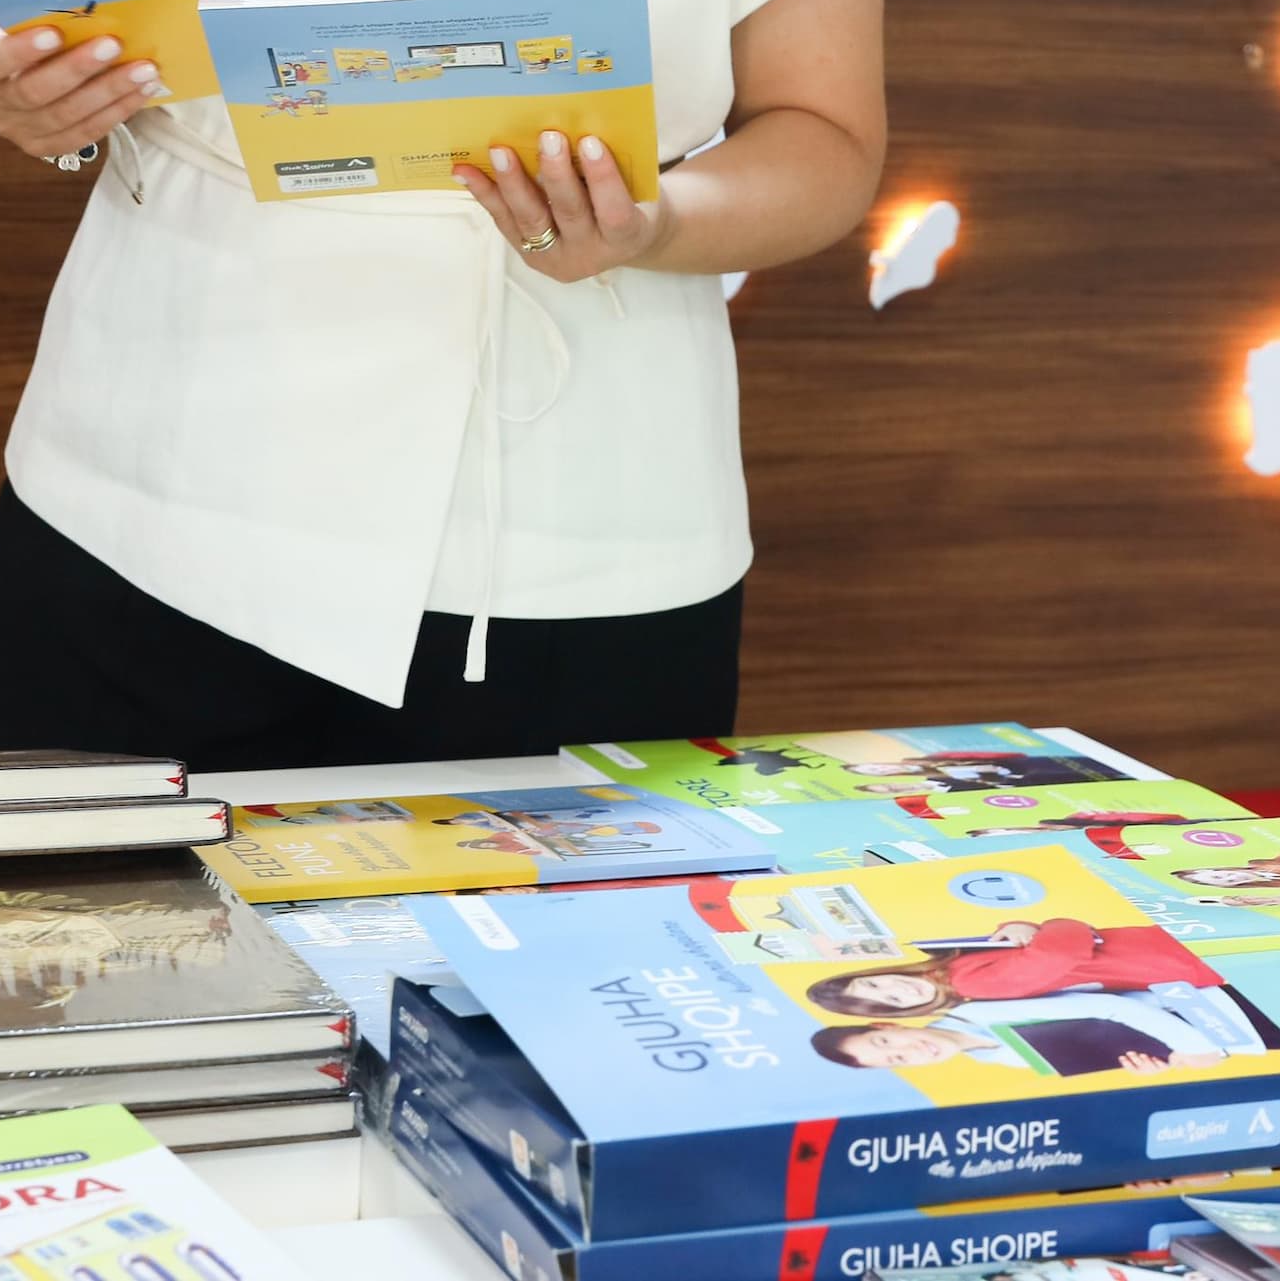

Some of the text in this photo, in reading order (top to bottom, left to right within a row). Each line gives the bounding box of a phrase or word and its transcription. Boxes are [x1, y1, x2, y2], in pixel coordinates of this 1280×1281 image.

[676, 778, 749, 807] TORE
[276, 842, 344, 877] PUNE
[590, 976, 711, 1072] GJUHA
[640, 966, 780, 1068] SHQIPE
[848, 1119, 1060, 1172] GJUHA SHQIPE
